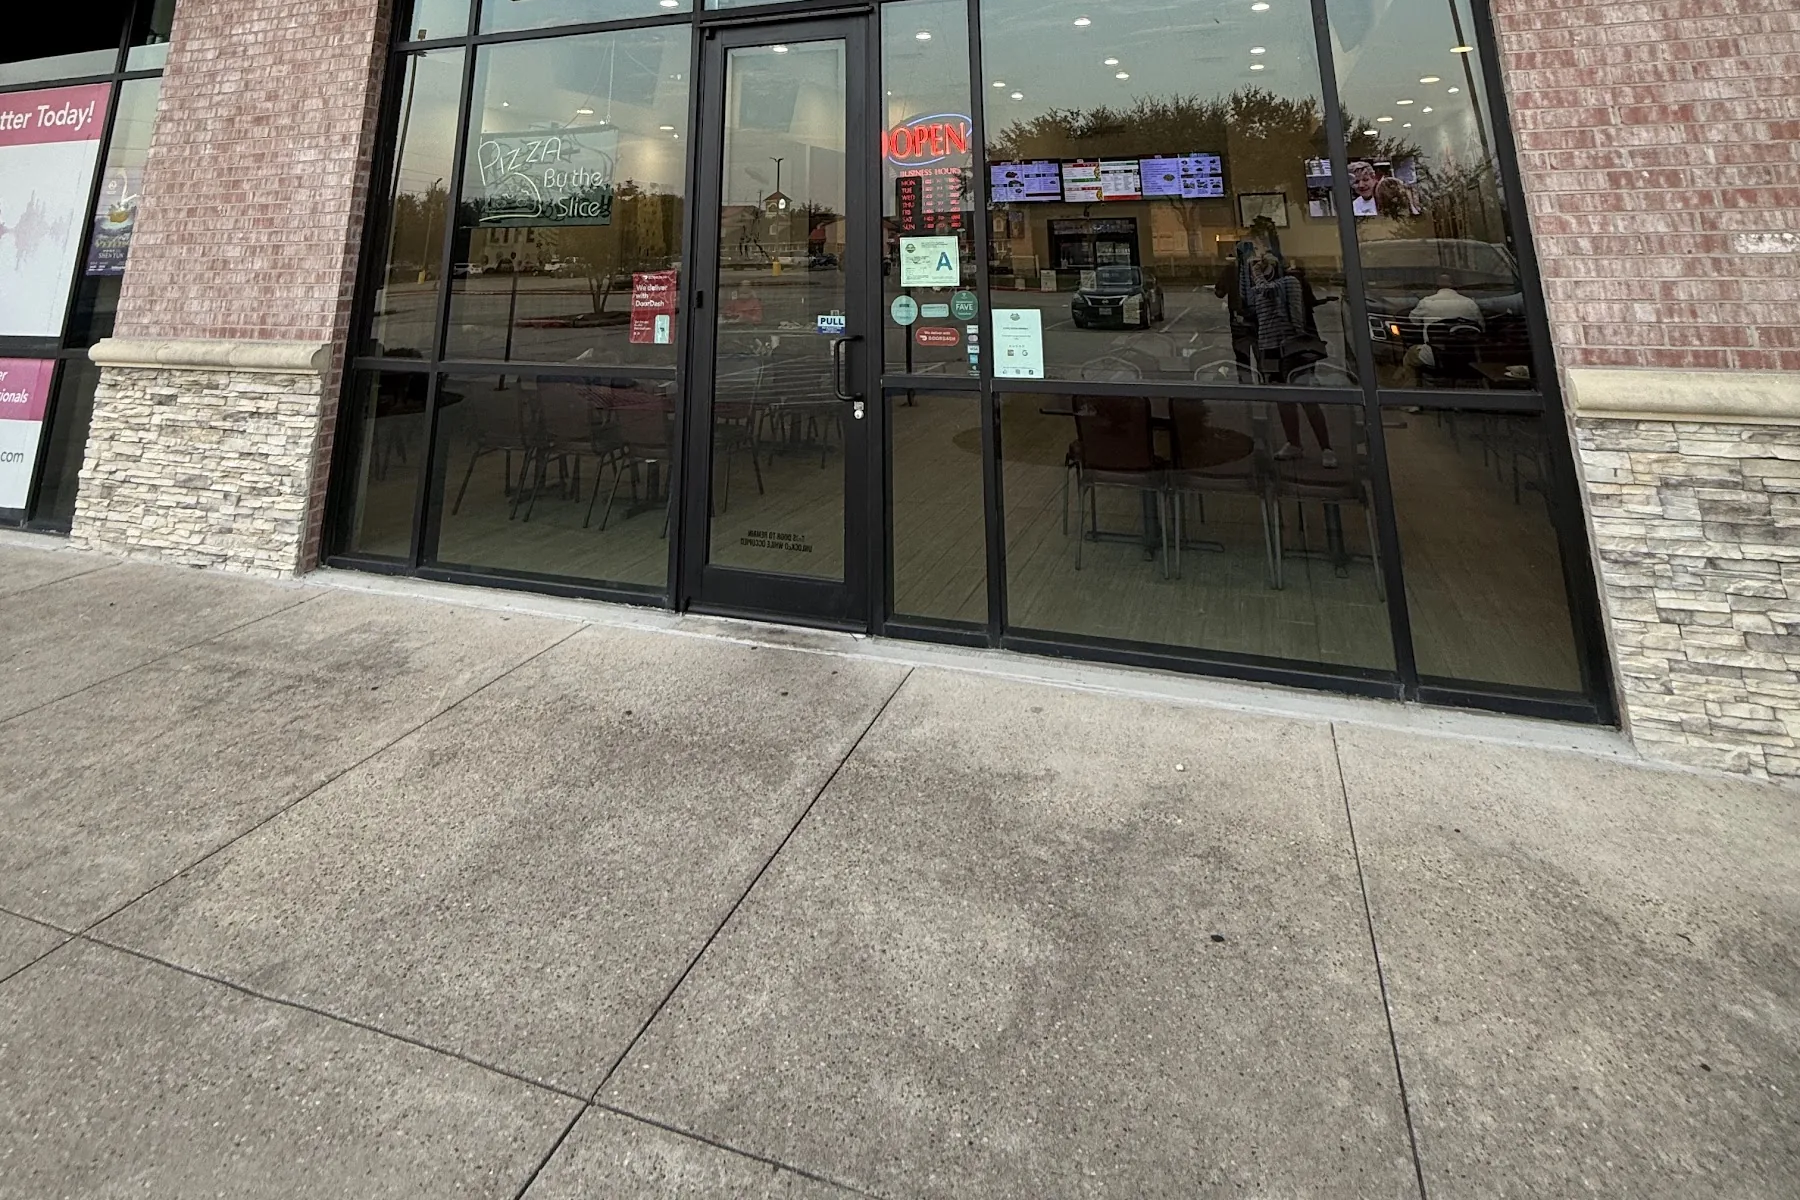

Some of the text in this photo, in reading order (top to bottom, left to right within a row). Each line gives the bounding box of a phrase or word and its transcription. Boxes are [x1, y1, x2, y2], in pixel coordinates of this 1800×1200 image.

[37, 100, 95, 131] Today!
[890, 122, 967, 159] OPEN
[478, 137, 561, 186] PIZZA
[544, 166, 602, 192] By the
[900, 167, 961, 177] BUSINESS HOURS
[936, 251, 953, 271] A
[956, 303, 974, 311] FAVE
[820, 317, 844, 326] PULL
[0, 388, 28, 403] ionals
